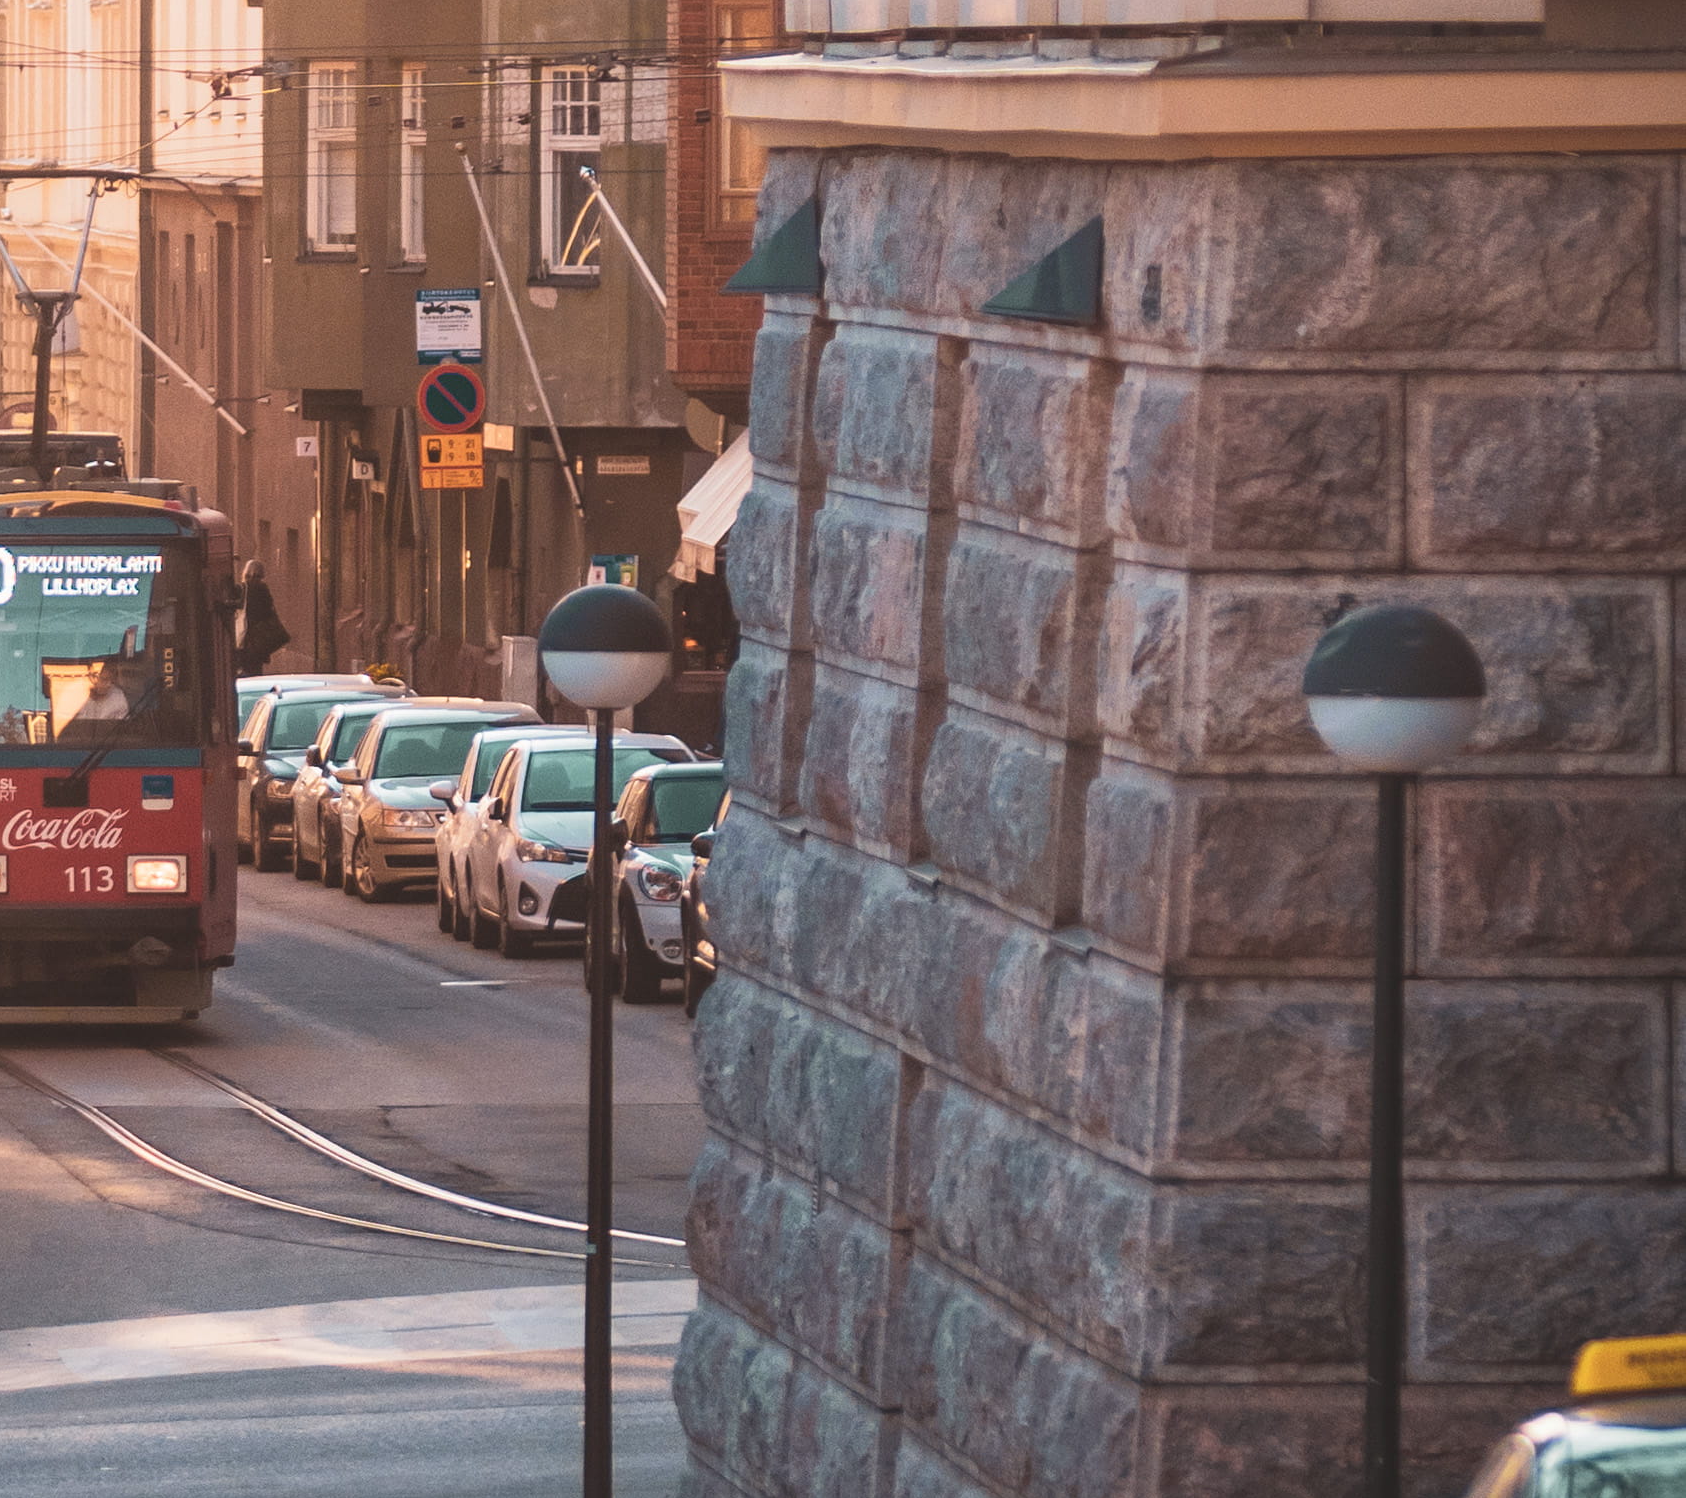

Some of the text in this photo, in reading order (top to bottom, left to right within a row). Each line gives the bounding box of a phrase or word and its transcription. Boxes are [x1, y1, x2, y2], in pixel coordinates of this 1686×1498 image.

[303, 441, 312, 453] 7
[360, 463, 369, 475] D
[17, 555, 163, 574] PIKKU HUOPALAHTI
[42, 578, 140, 596] LILLHOPLAX
[1, 808, 130, 850] Coca-Cola
[64, 865, 114, 892] 113
